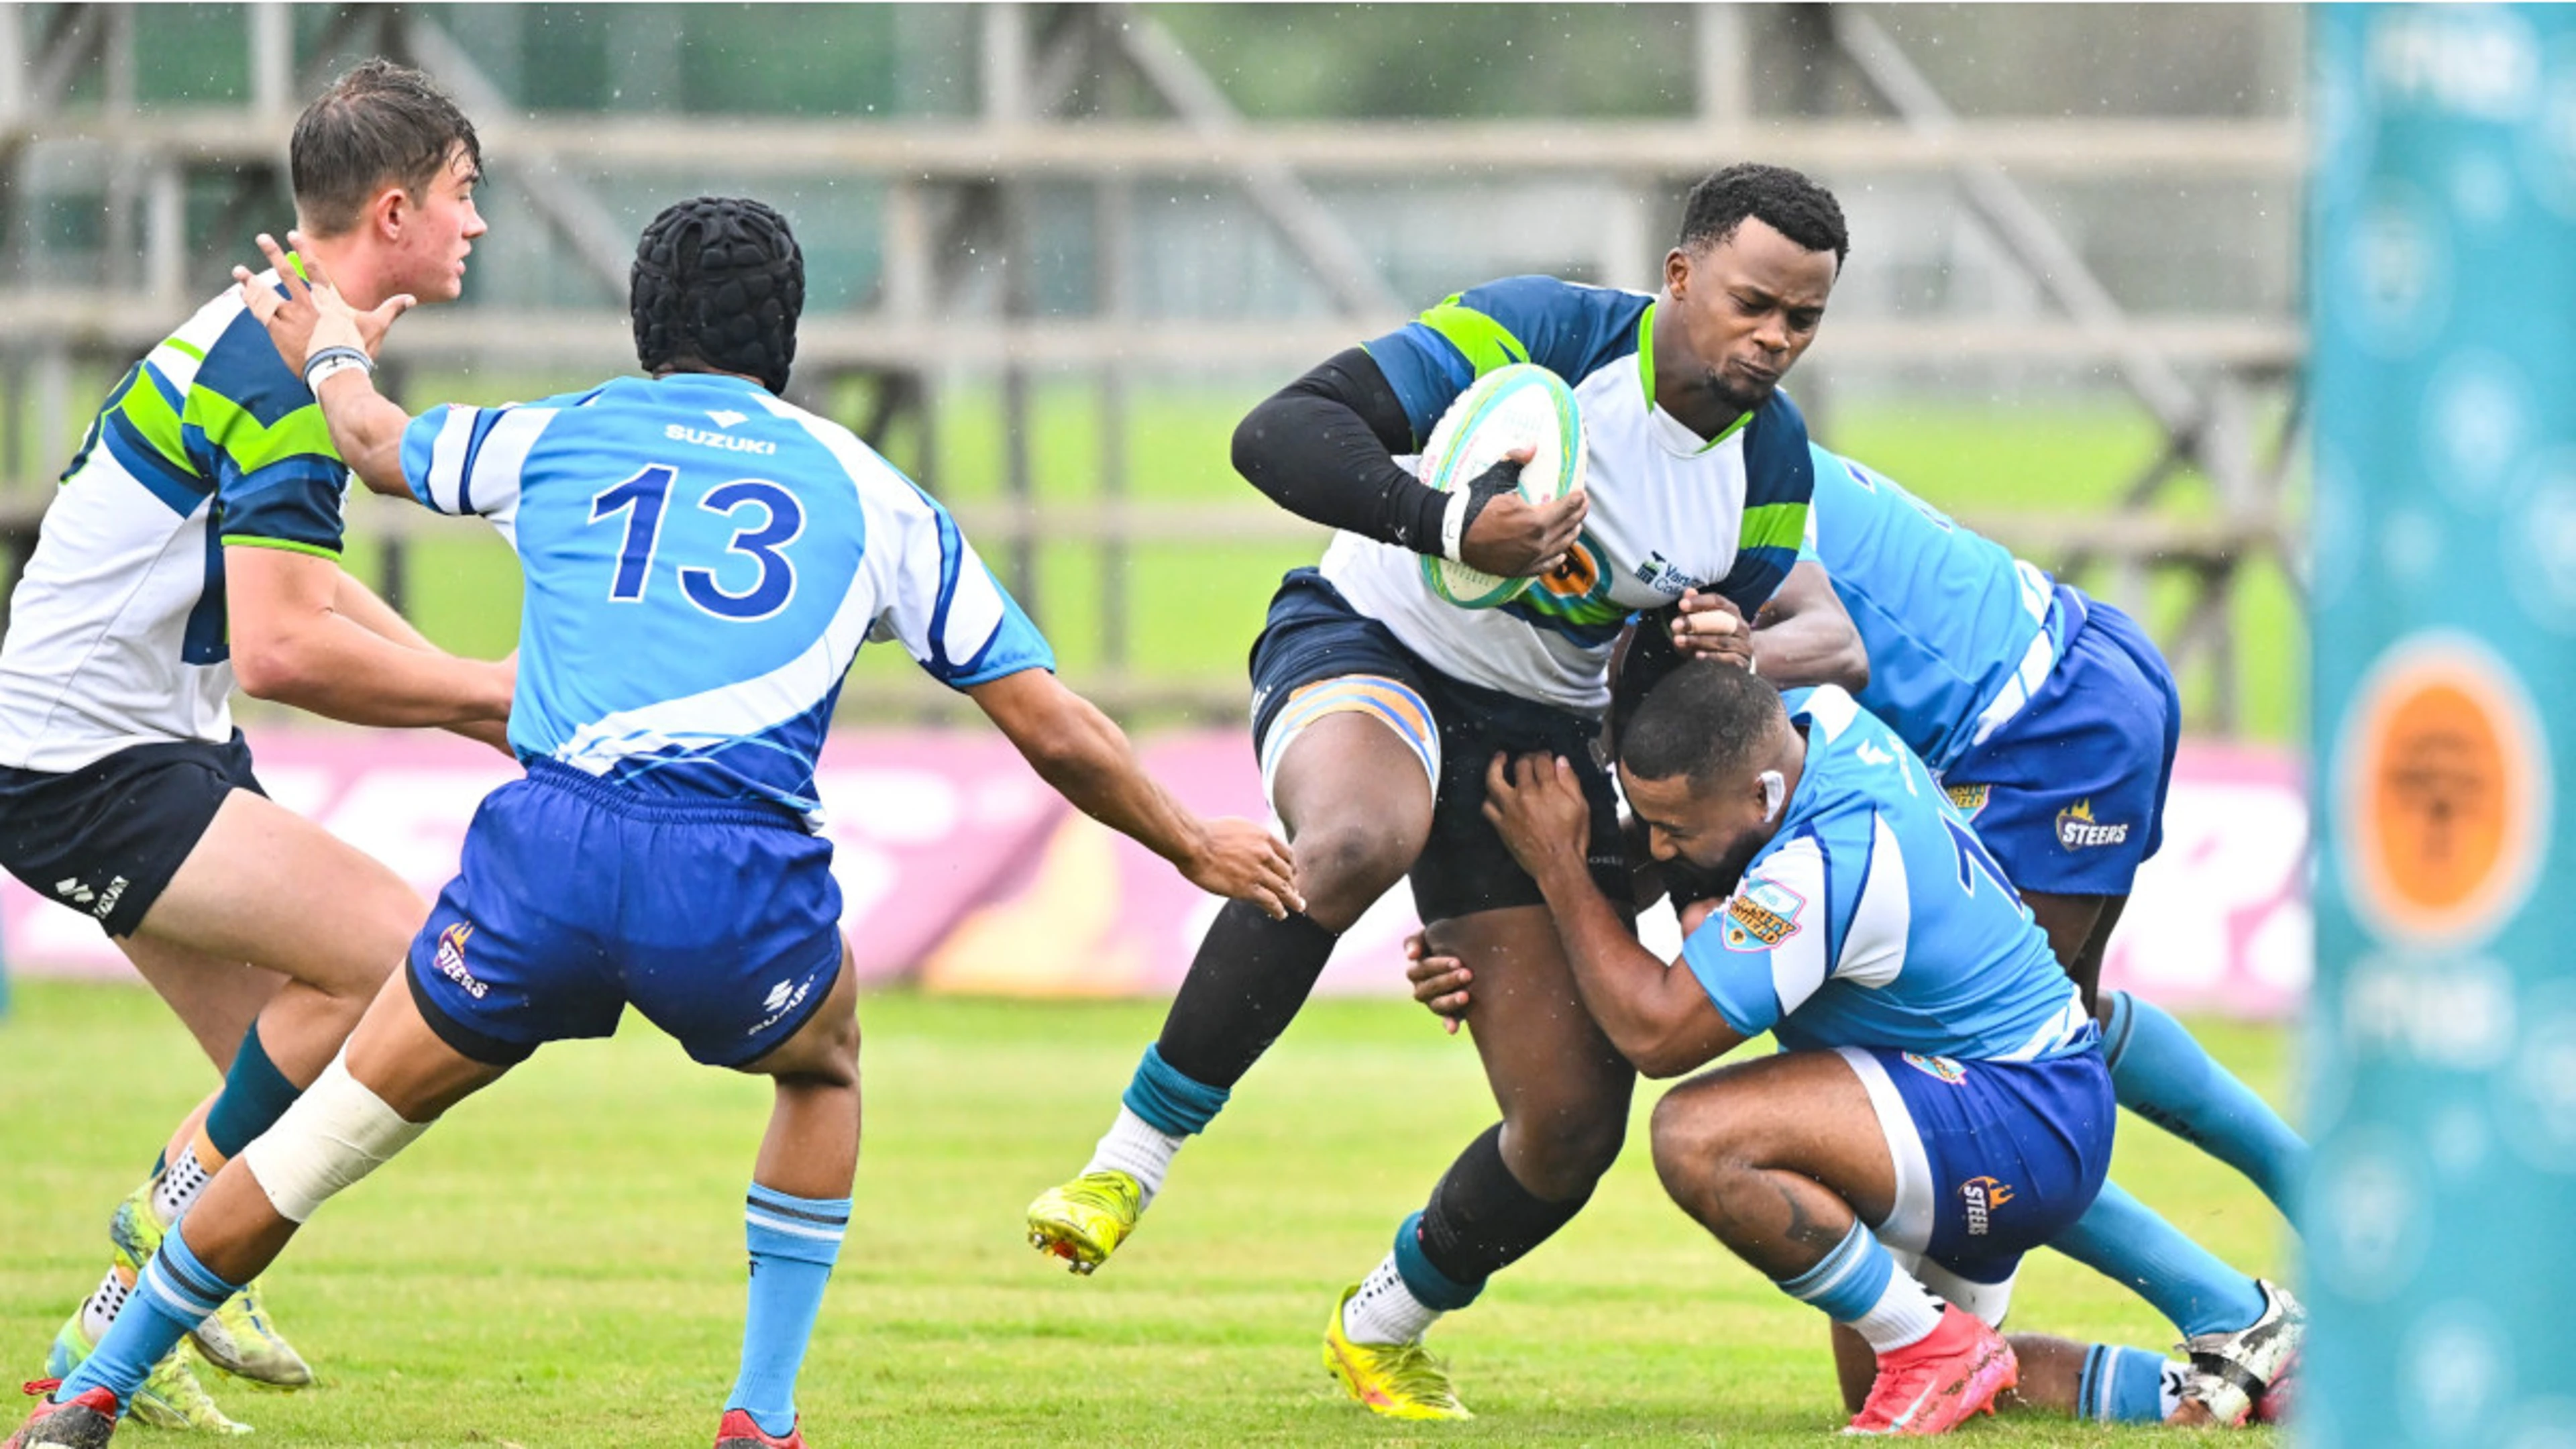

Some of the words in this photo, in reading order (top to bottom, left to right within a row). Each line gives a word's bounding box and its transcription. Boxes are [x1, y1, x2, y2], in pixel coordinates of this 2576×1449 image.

[663, 424, 777, 455] SUZUKI
[588, 462, 806, 623] 13
[2062, 822, 2129, 845] STEERS
[437, 940, 488, 999] STEERS
[1963, 1185, 1989, 1235] STEERS
